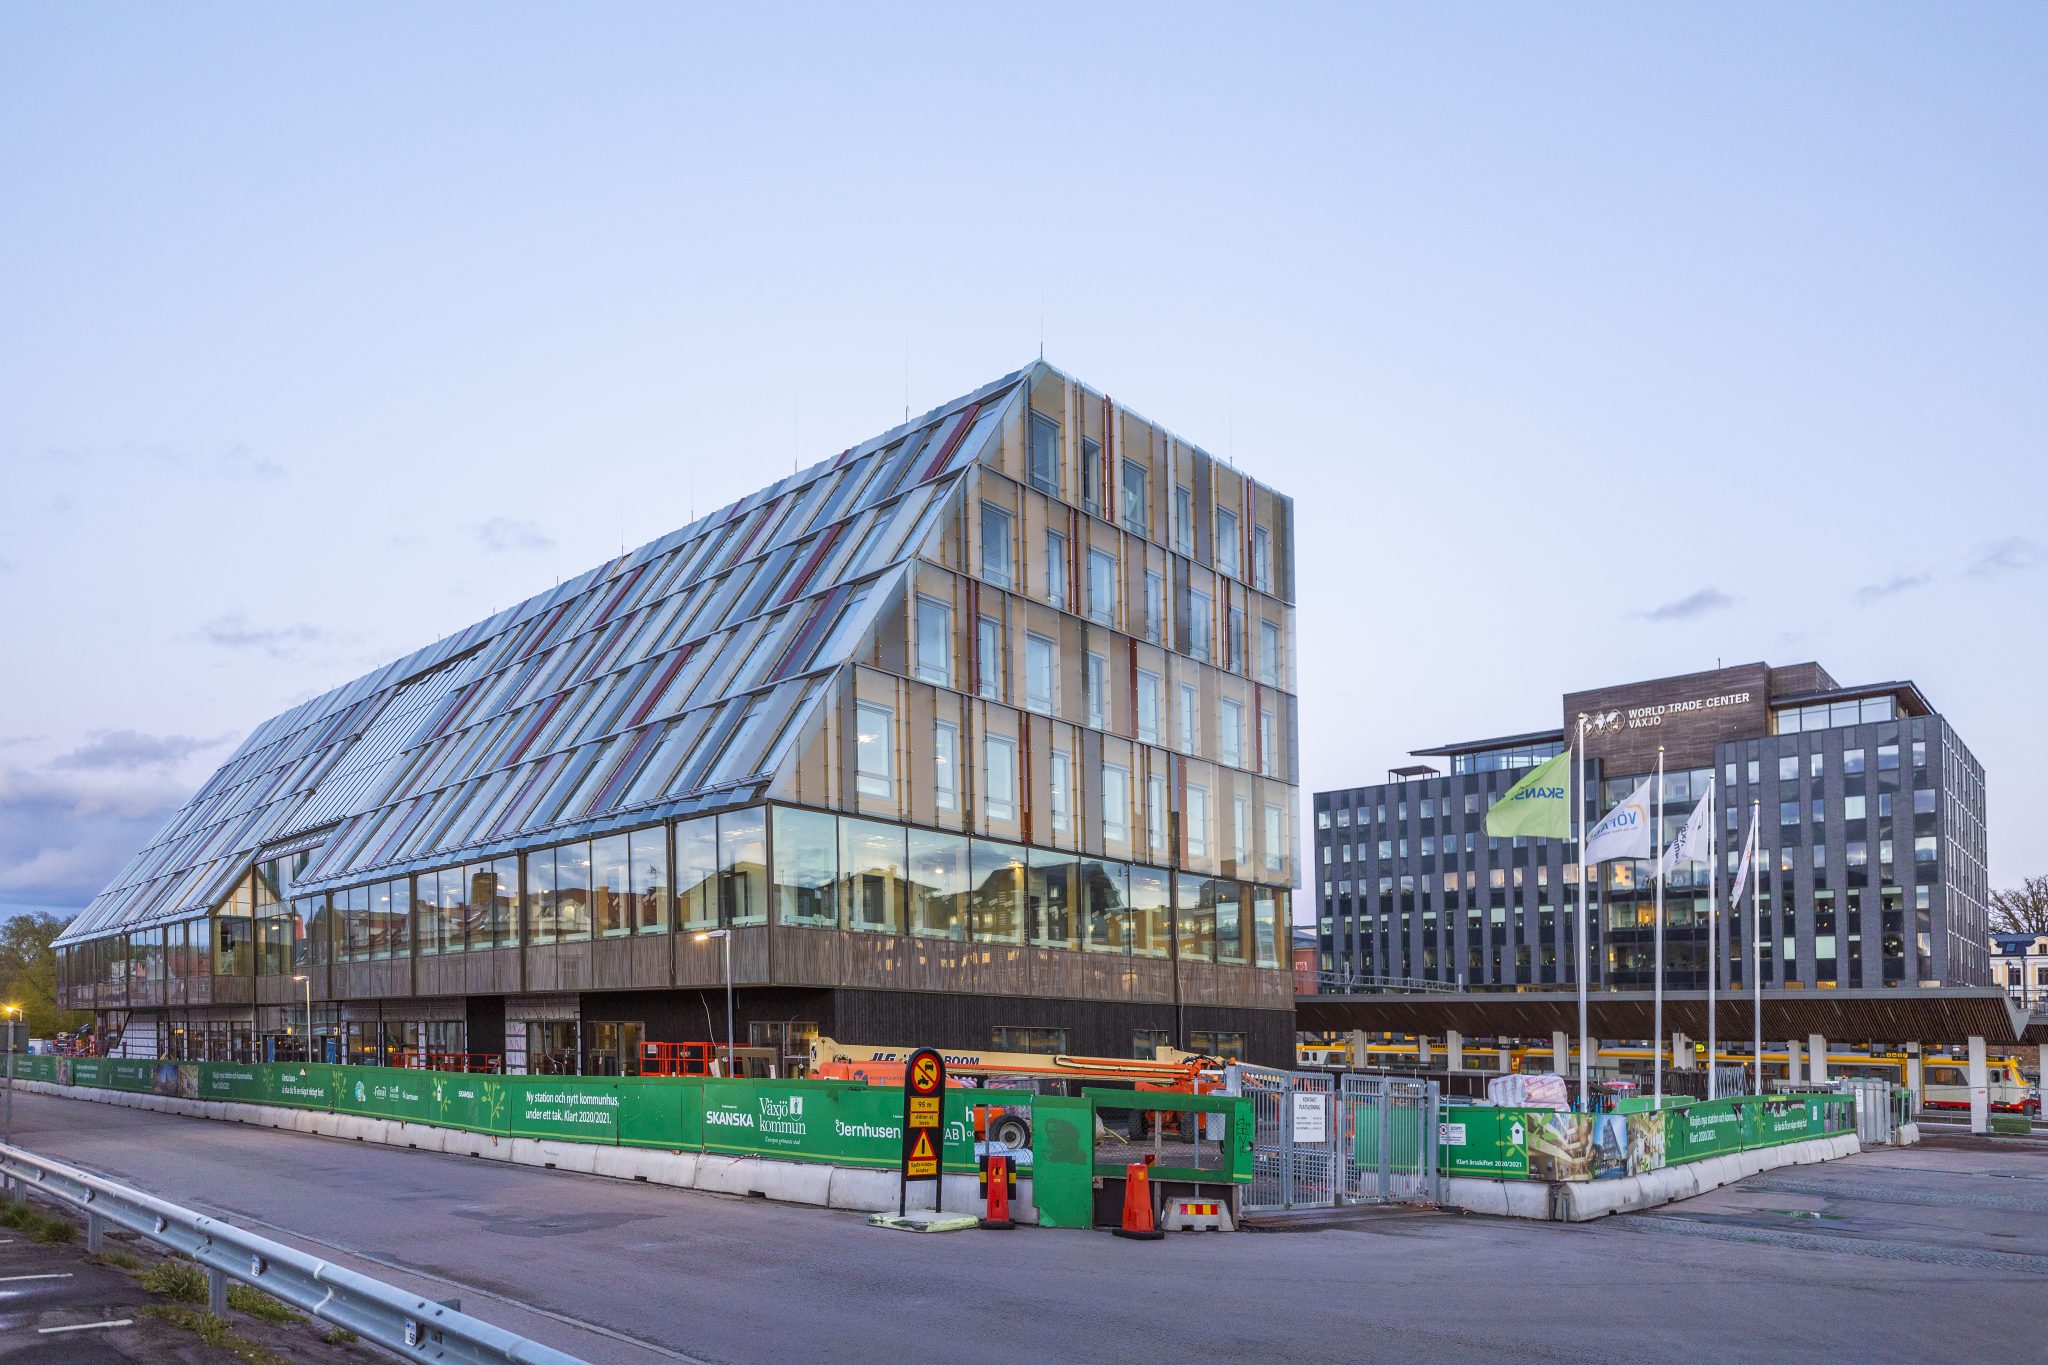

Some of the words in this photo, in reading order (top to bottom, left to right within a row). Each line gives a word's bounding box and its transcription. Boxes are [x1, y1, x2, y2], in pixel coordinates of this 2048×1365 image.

[1628, 705, 1665, 719] WORLD
[1668, 699, 1703, 714] TRADE
[1706, 692, 1750, 708] CENTER
[1628, 715, 1662, 729] VÄXJÖ
[869, 1053, 896, 1062] JLG
[526, 1091, 534, 1105] Ny
[534, 1092, 554, 1103] station
[554, 1092, 566, 1104] och
[566, 1094, 579, 1107] nytt
[579, 1093, 620, 1107] kommunhus,
[525, 1108, 542, 1120] under
[542, 1110, 551, 1120] ett
[564, 1109, 578, 1122] Klart
[579, 1111, 612, 1124] 2020/2021.
[759, 1097, 789, 1120] Växjö
[706, 1110, 754, 1128] SKANSKA
[759, 1114, 806, 1135] kommun
[838, 1121, 901, 1139] Jernhusen
[1494, 1160, 1522, 1168] 2020/2021
